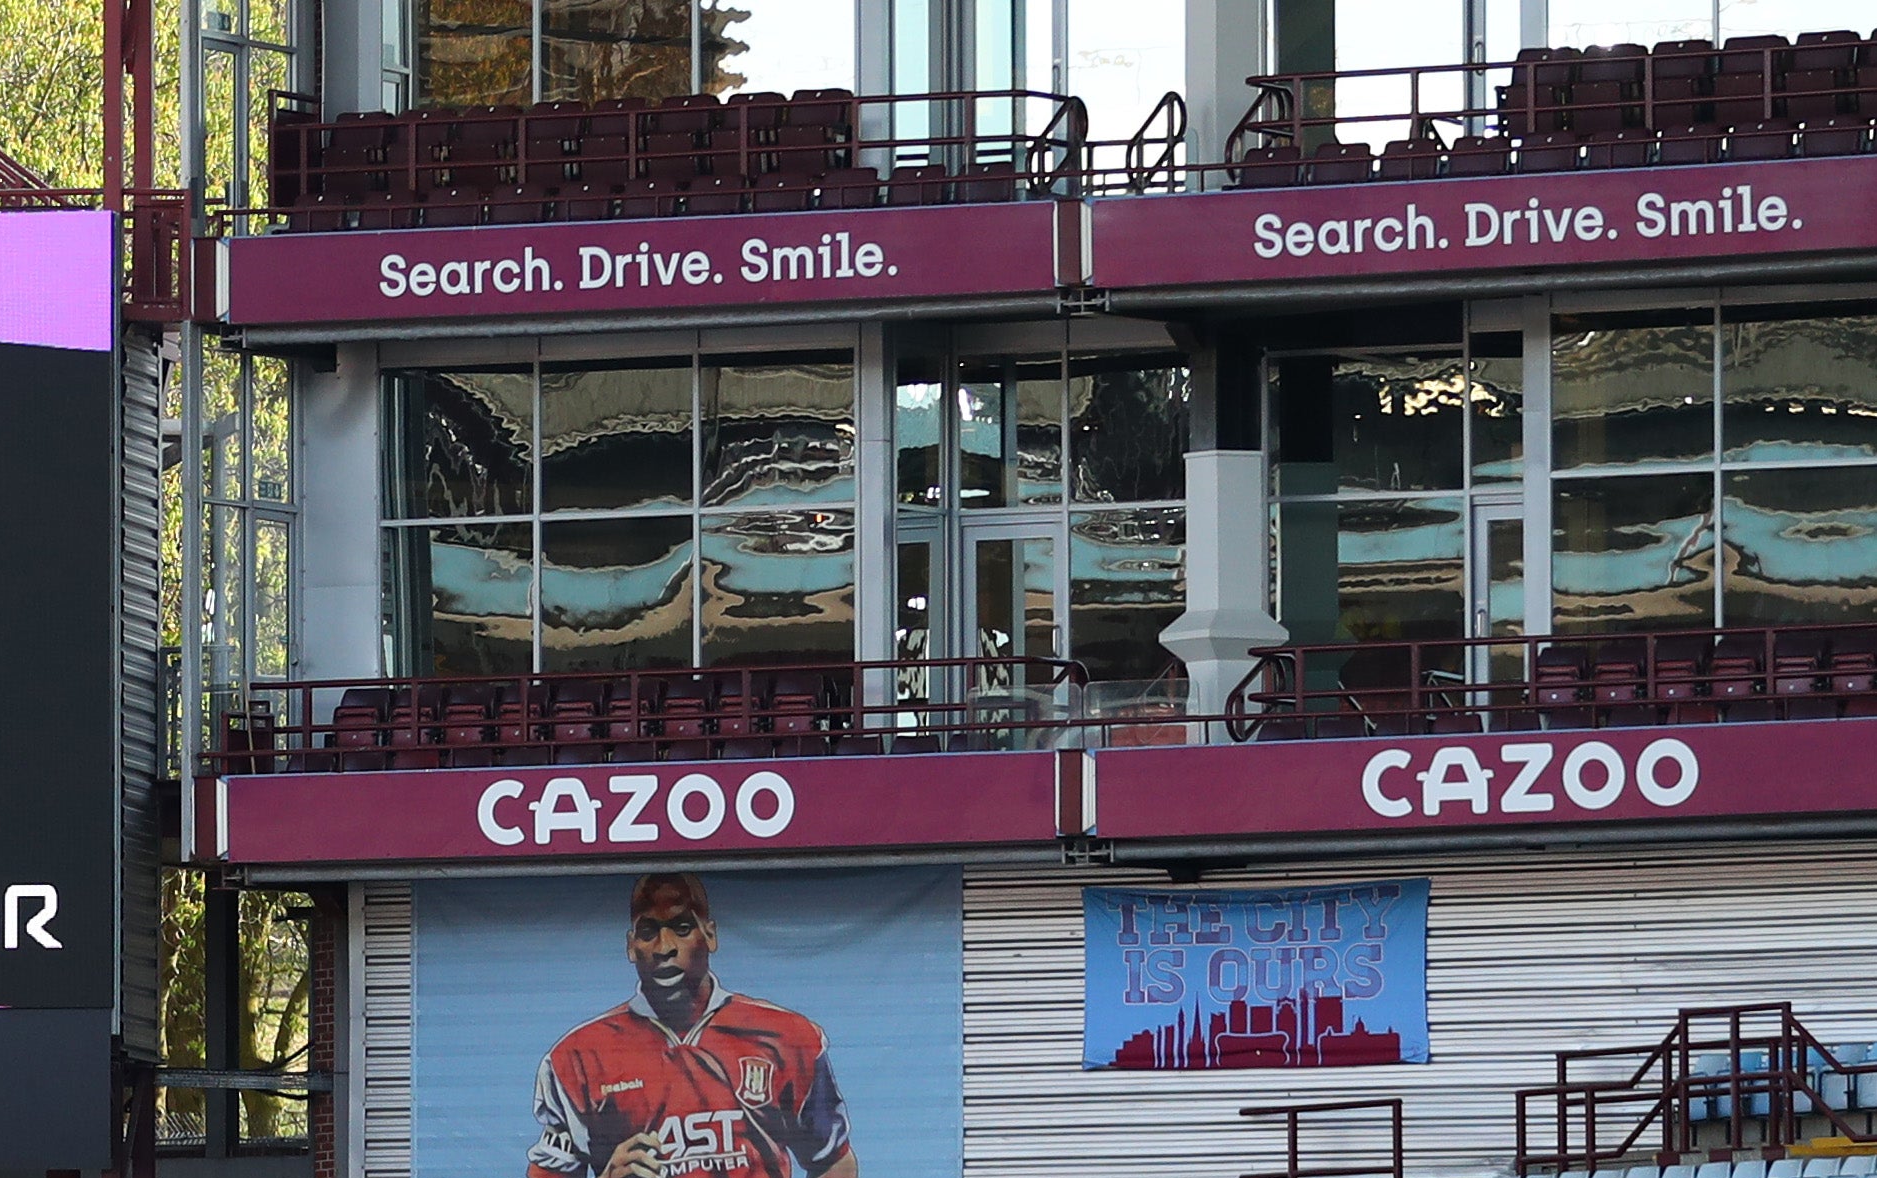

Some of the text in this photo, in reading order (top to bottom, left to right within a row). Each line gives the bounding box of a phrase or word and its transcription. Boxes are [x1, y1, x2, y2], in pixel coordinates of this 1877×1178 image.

[1253, 184, 1803, 259] Search. Drive. Smile.
[378, 231, 899, 298] Search. Drive. Smile.
[477, 771, 796, 846] CAZOO
[1362, 738, 1700, 818] CAZOO
[1106, 884, 1401, 946] THE CITY
[1124, 943, 1384, 1005] IS OURS
